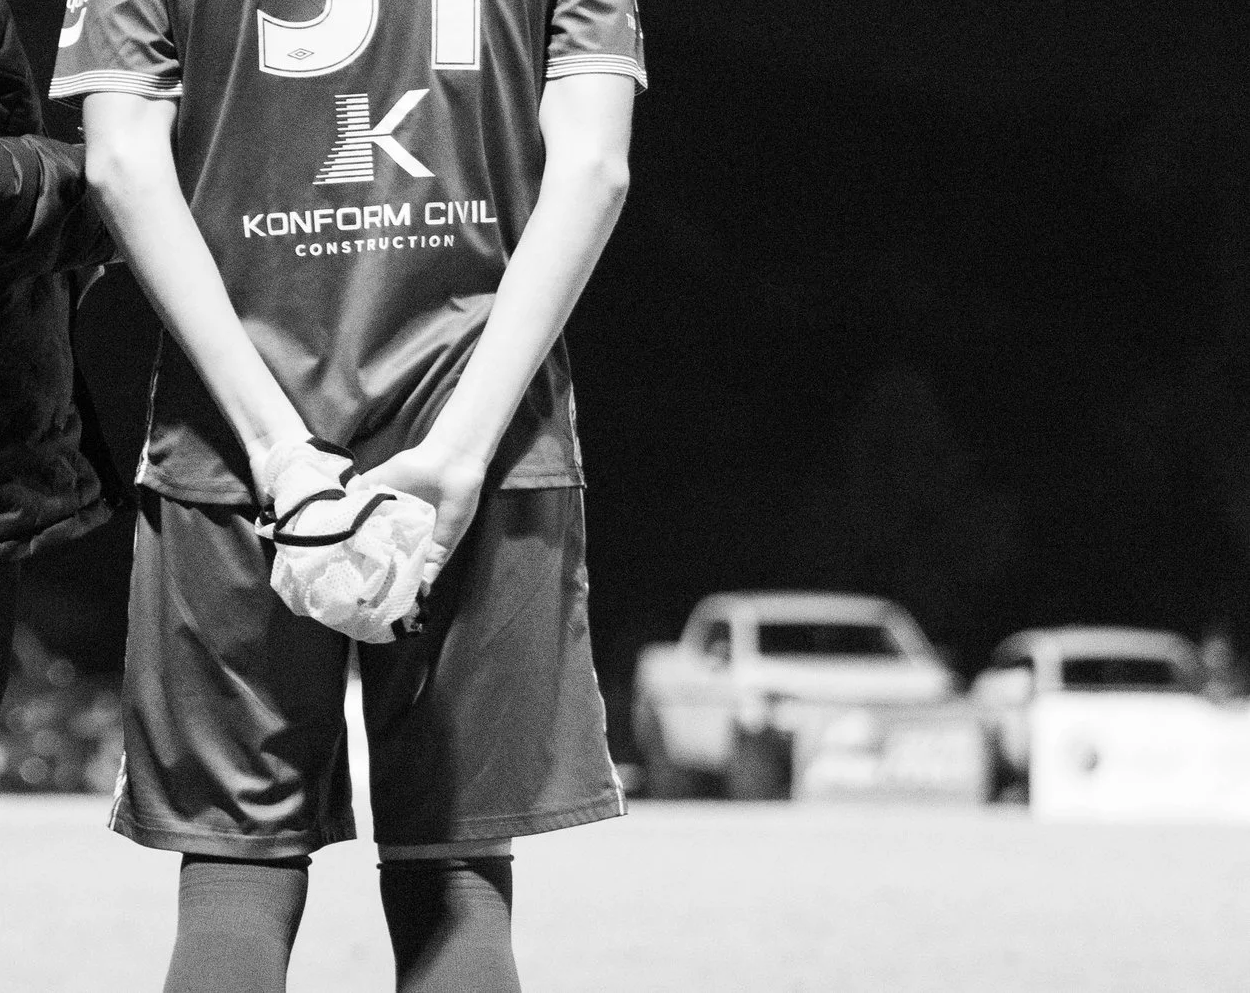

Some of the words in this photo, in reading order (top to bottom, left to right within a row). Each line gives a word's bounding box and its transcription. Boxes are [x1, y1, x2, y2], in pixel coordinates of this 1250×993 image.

[242, 202, 412, 238] KONFORM
[424, 200, 498, 226] CIVIL
[295, 235, 455, 257] CONSTRUCTION
